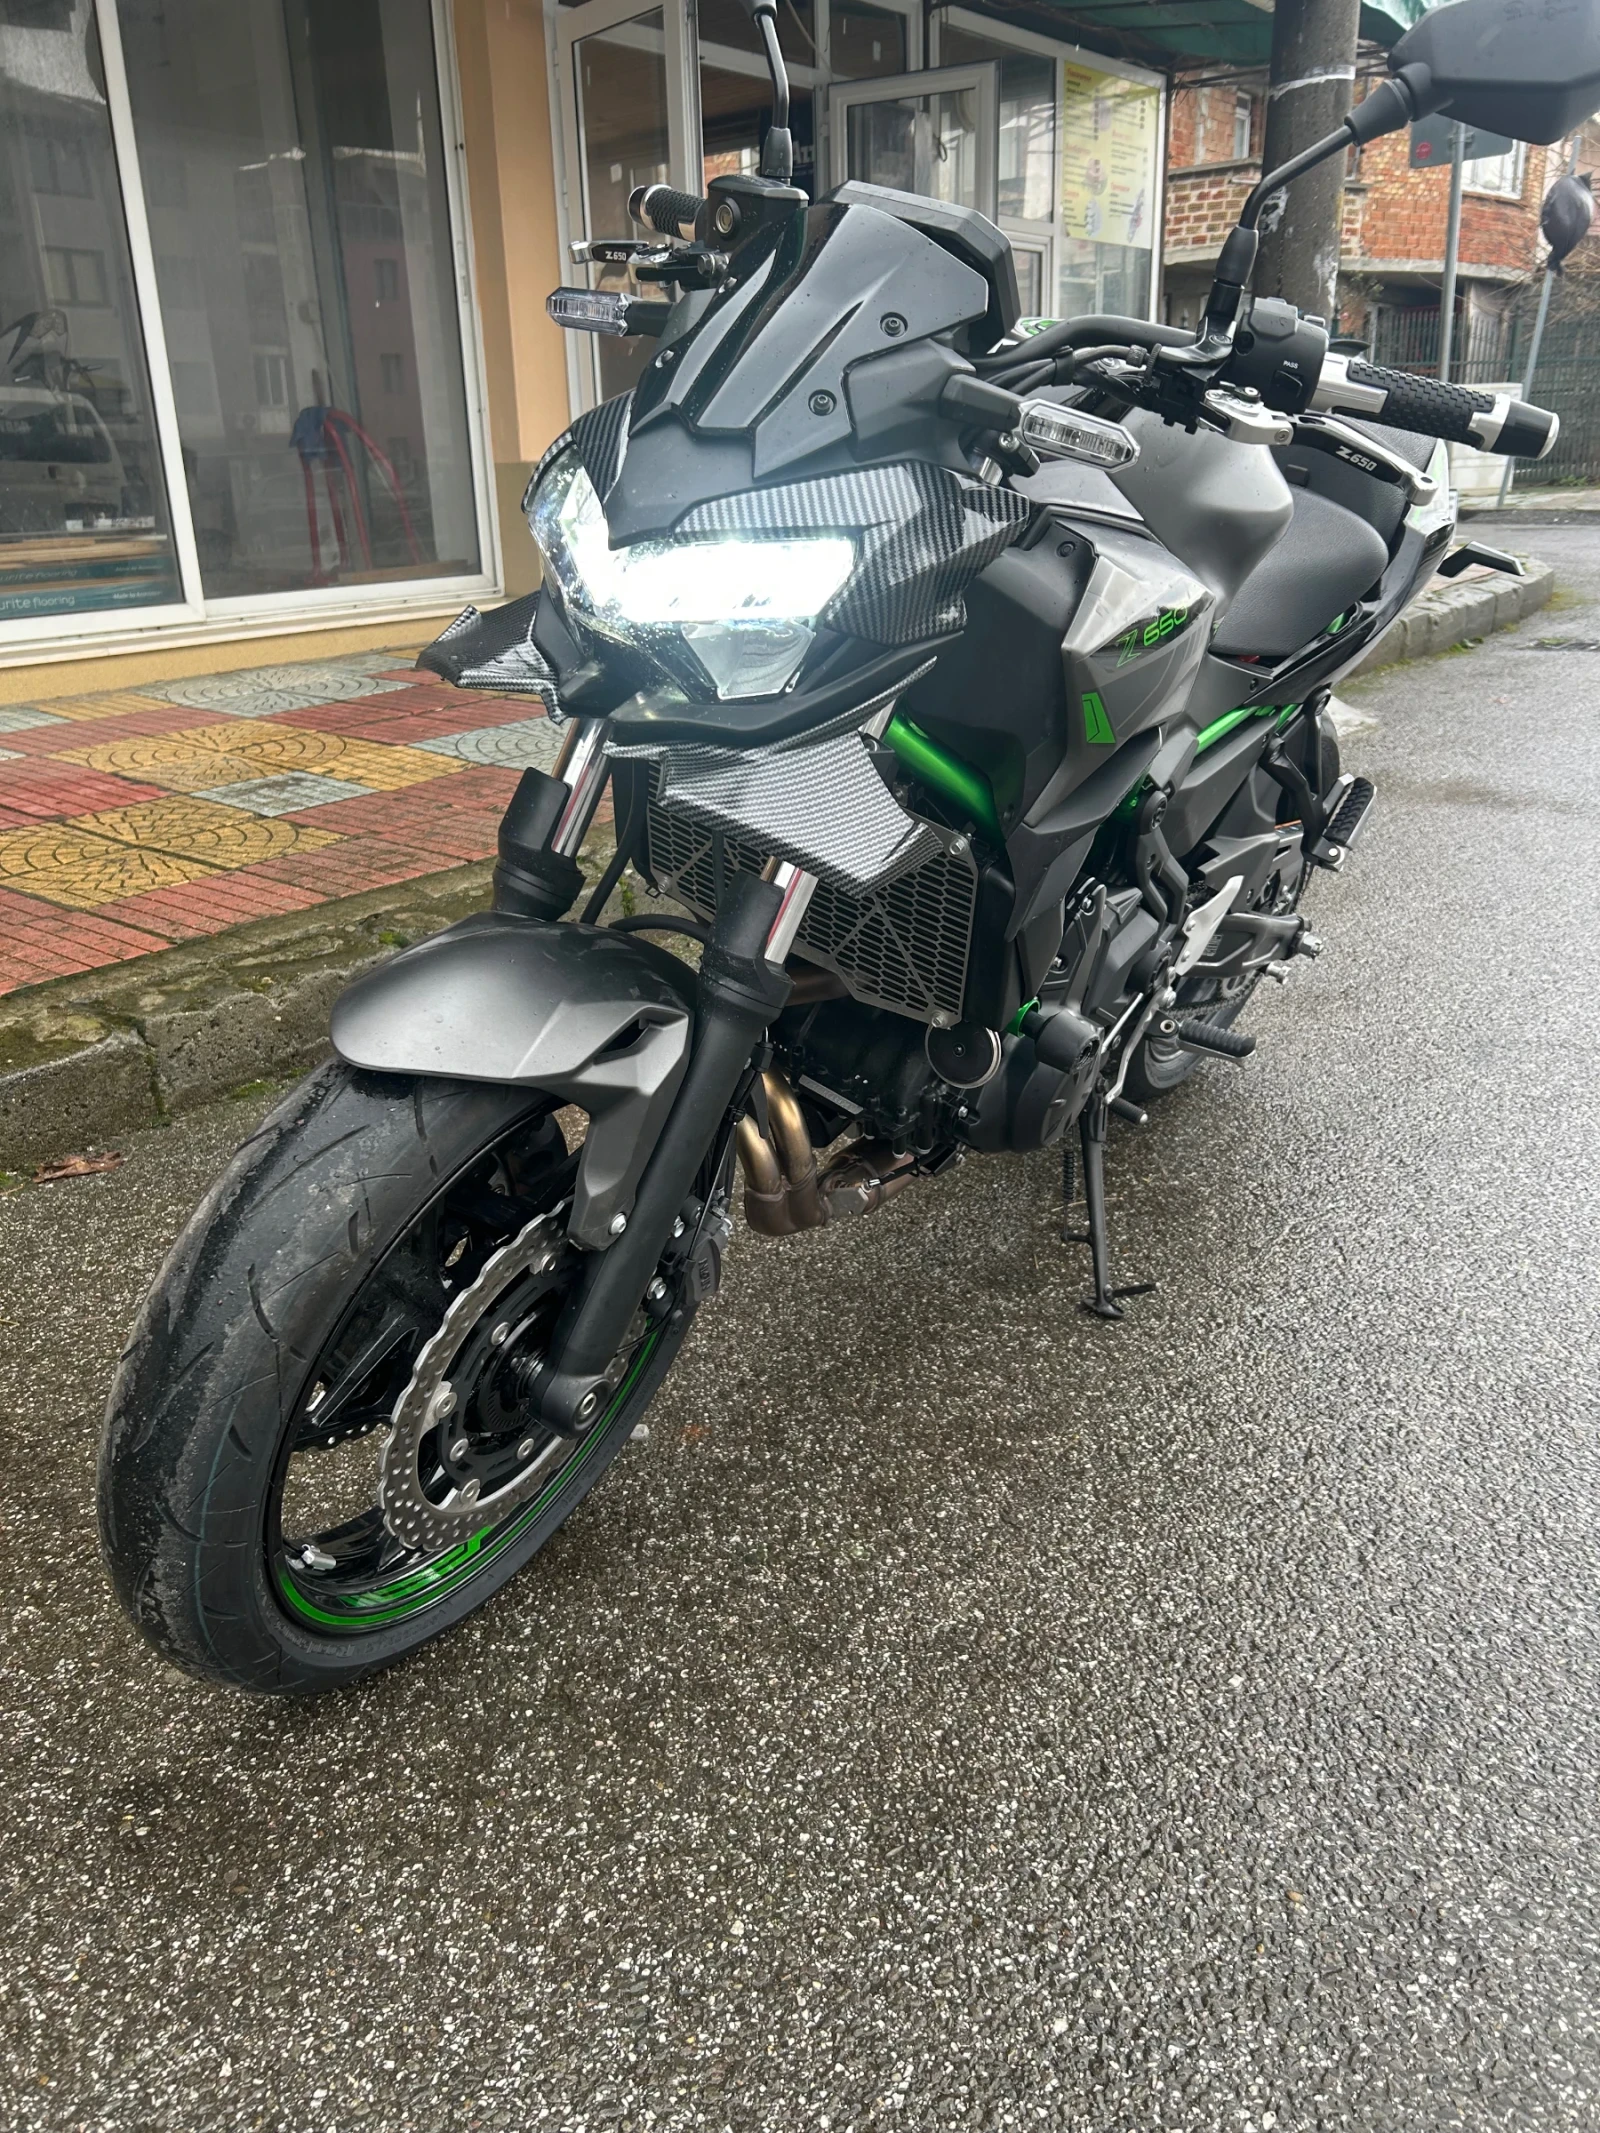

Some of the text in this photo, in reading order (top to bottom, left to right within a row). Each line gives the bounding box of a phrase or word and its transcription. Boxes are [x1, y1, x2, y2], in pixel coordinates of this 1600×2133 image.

[1283, 360, 1299, 369] PASS
[1335, 445, 1378, 471] Z650
[33, 596, 75, 609] flooring
